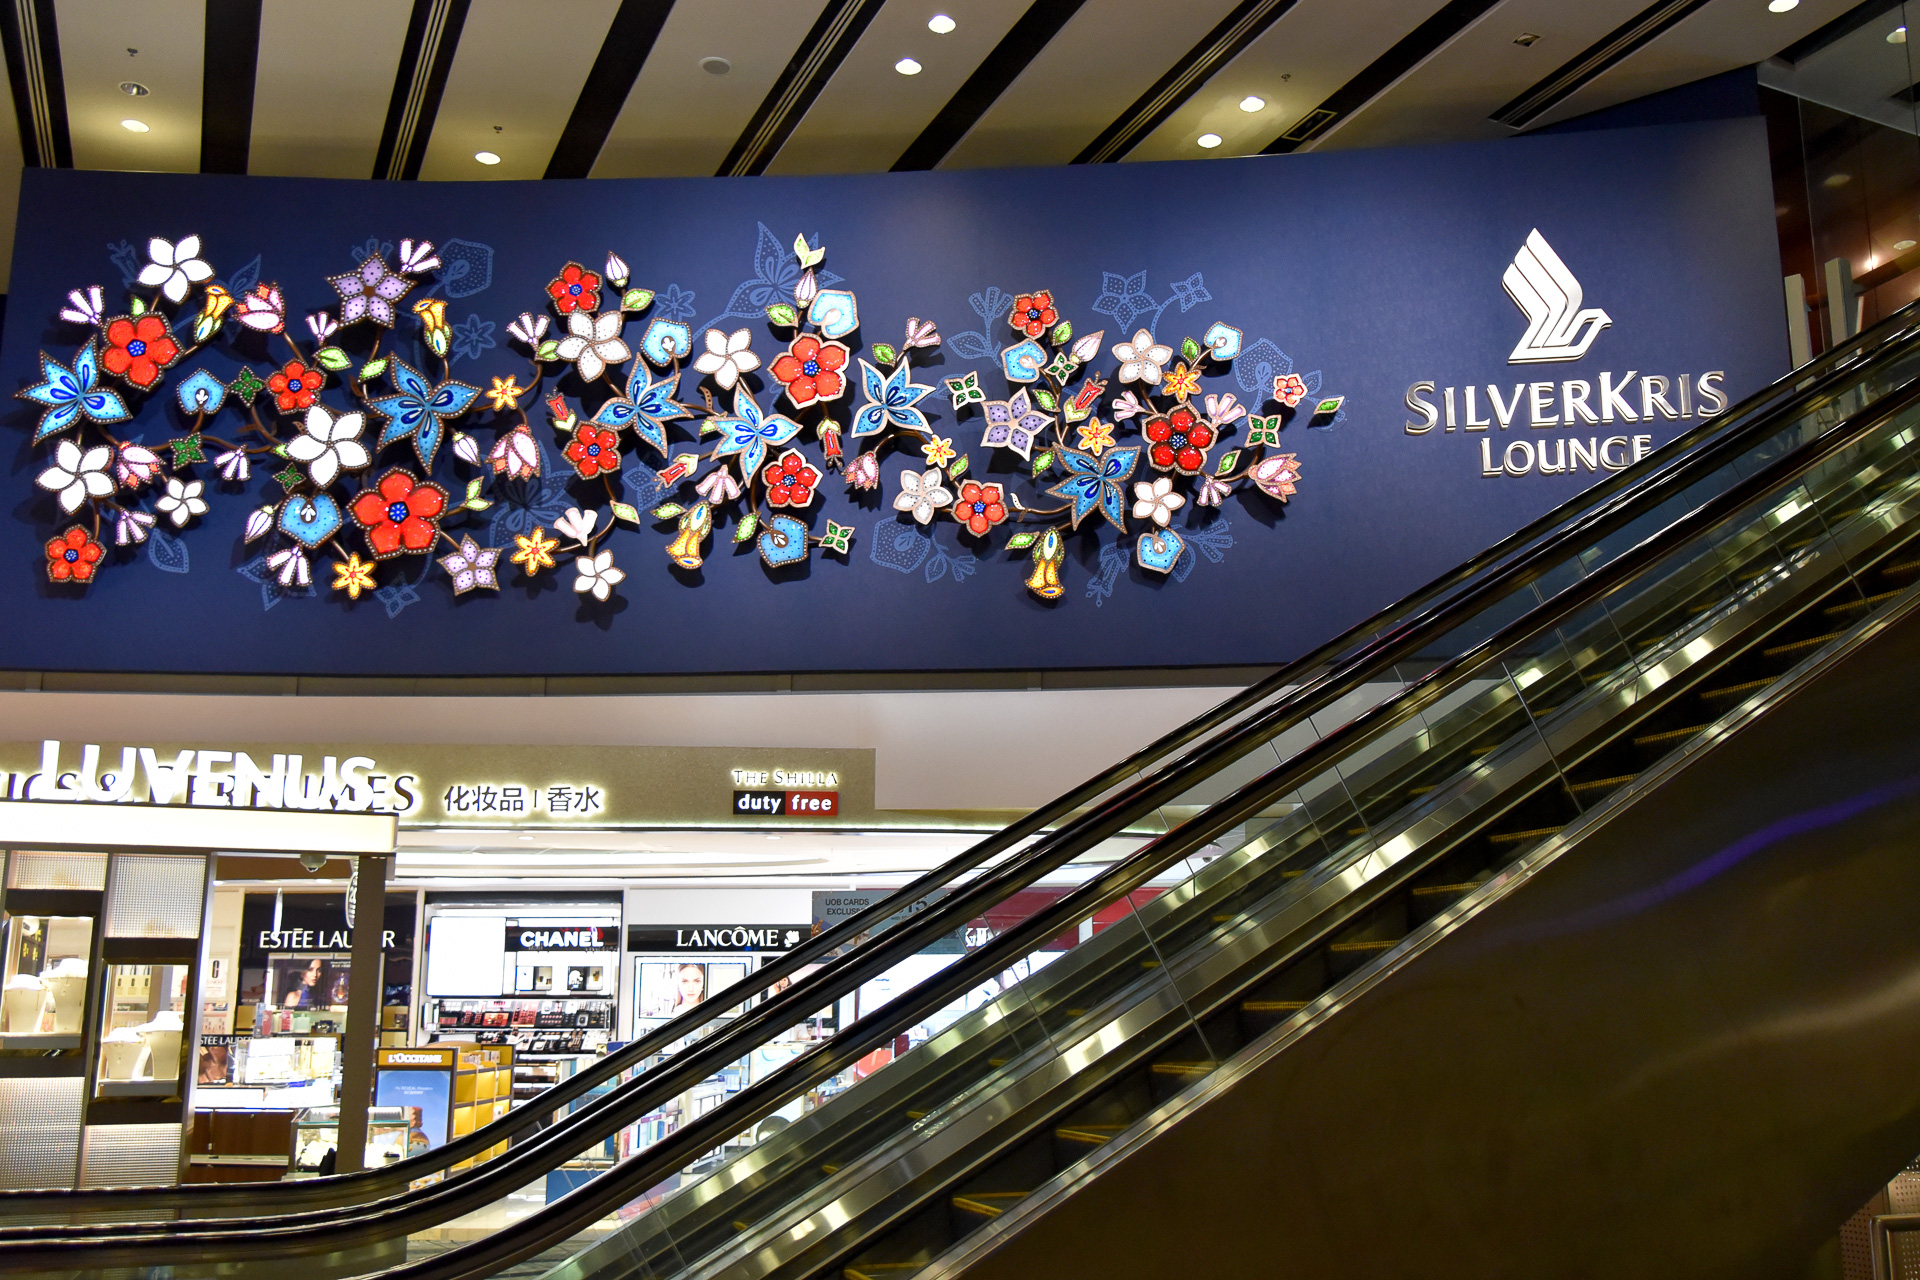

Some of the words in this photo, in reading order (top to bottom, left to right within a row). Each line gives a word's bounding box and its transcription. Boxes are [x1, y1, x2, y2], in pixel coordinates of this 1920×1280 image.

[1404, 371, 1728, 434] SILVERKRIS
[1480, 435, 1652, 478] LOUNGE
[41, 739, 376, 812] LUVENUS
[733, 770, 767, 785] THE
[774, 770, 838, 785] SHILLA
[444, 785, 524, 812] 化妆品
[547, 786, 600, 812] 香水
[737, 793, 782, 814] duty
[791, 794, 832, 811] free
[825, 898, 842, 906] UOB
[843, 898, 870, 906] CARDS
[826, 907, 865, 916] EXCLUS
[319, 930, 396, 949] LAUR
[520, 931, 604, 948] CHANEL
[676, 926, 779, 947] LANCÔME
